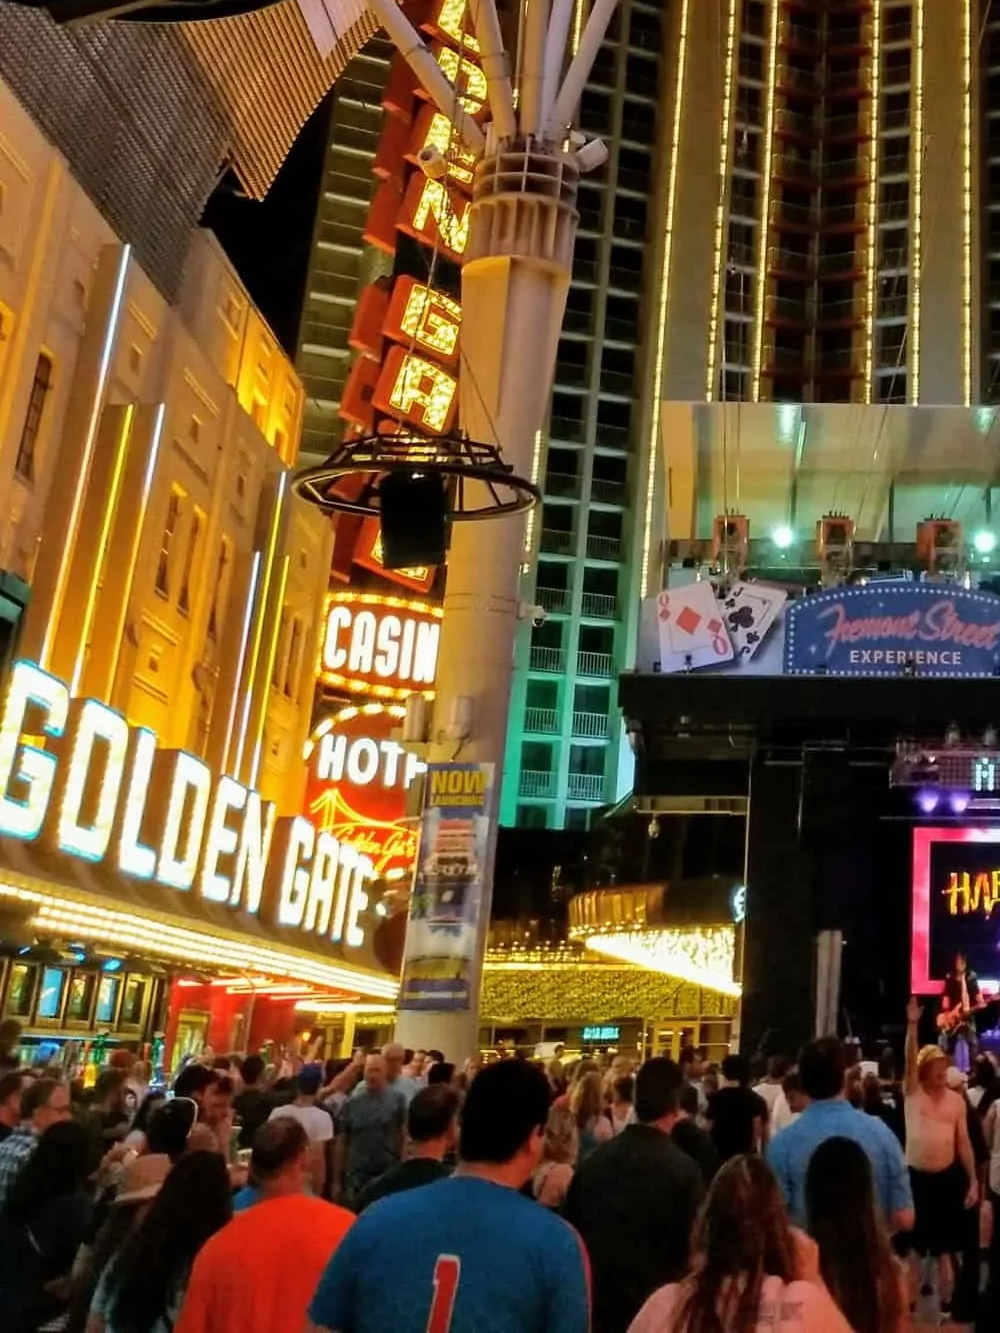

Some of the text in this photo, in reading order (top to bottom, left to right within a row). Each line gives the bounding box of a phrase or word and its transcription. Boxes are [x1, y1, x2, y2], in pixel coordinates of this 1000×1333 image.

[817, 602, 921, 659] Fremont
[849, 649, 962, 665] EXPERIENCE
[431, 770, 485, 794] NOW
[0, 659, 374, 948] GOLDEN GATE
